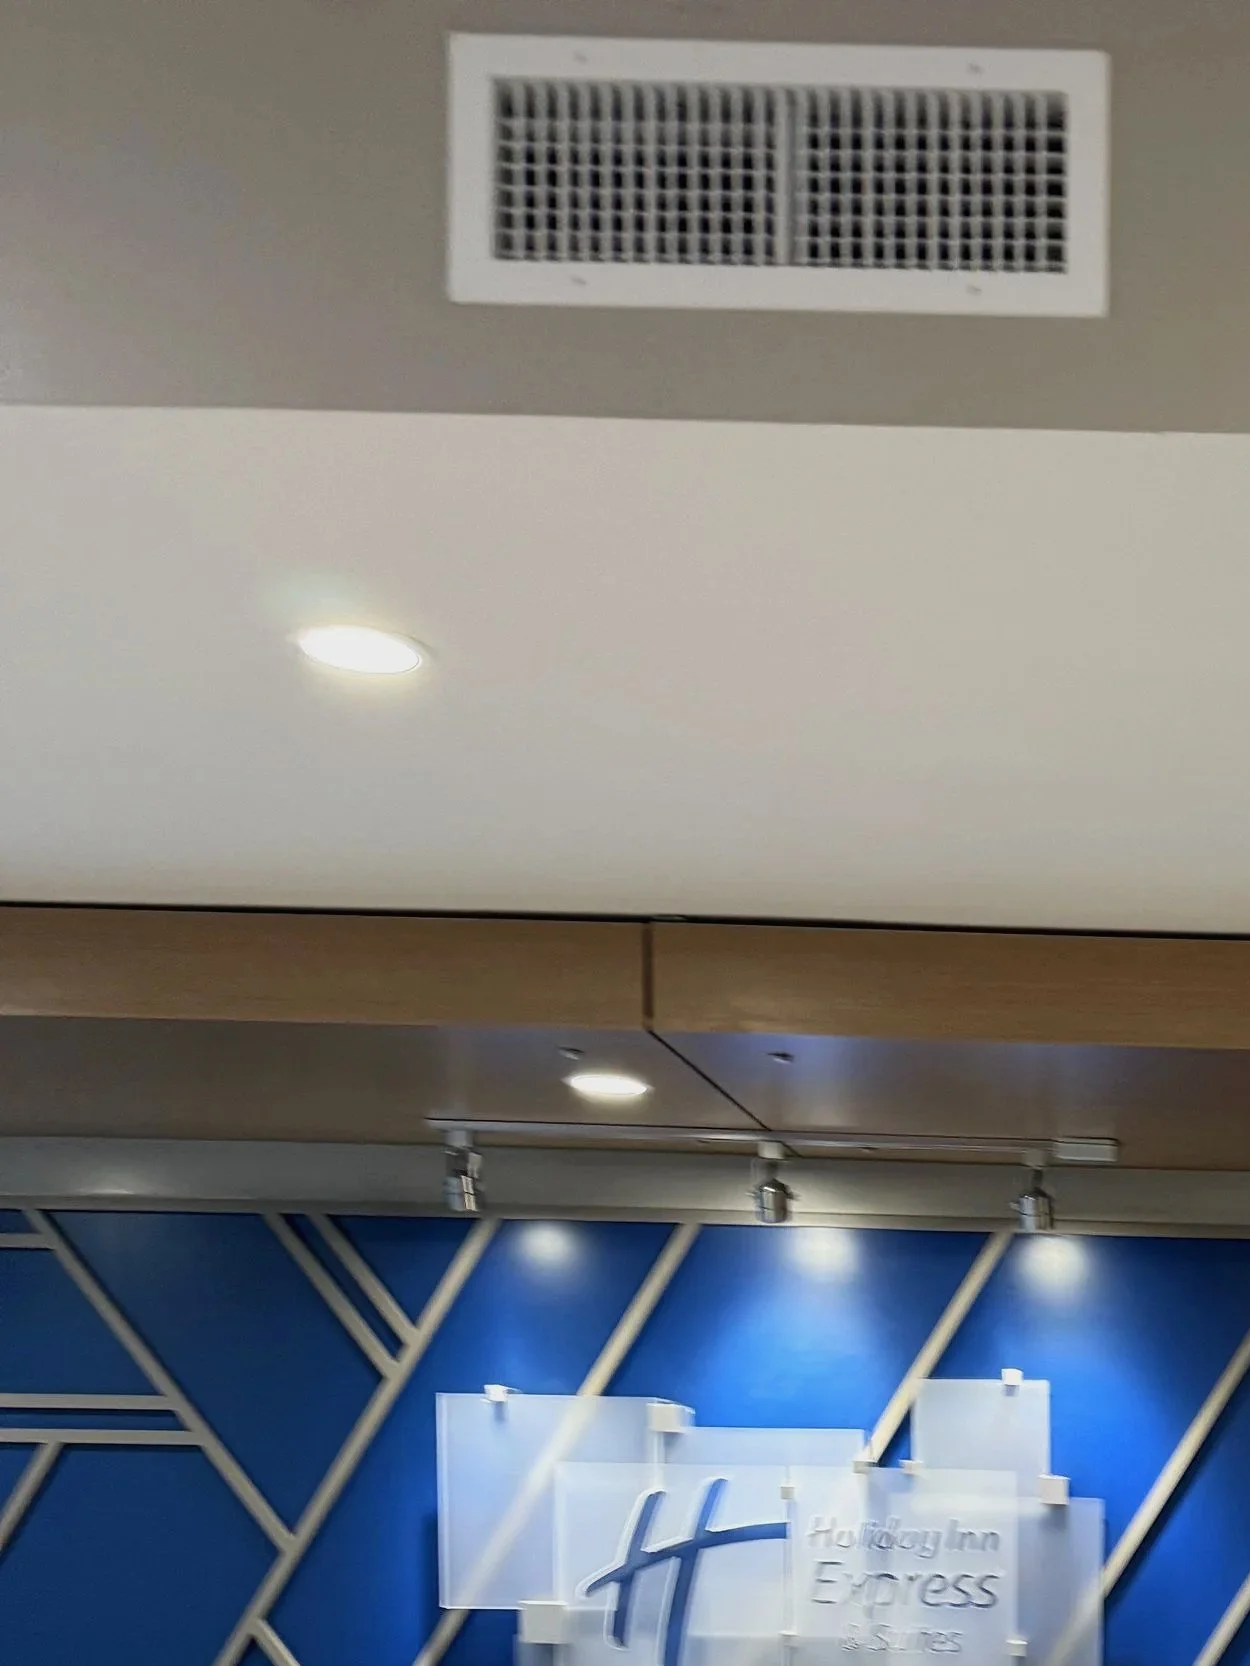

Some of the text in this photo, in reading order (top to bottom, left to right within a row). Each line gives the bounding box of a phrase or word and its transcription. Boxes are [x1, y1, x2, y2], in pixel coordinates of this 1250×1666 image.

[806, 1515, 1001, 1559] Holiday Inn
[810, 1559, 1002, 1620] Express
